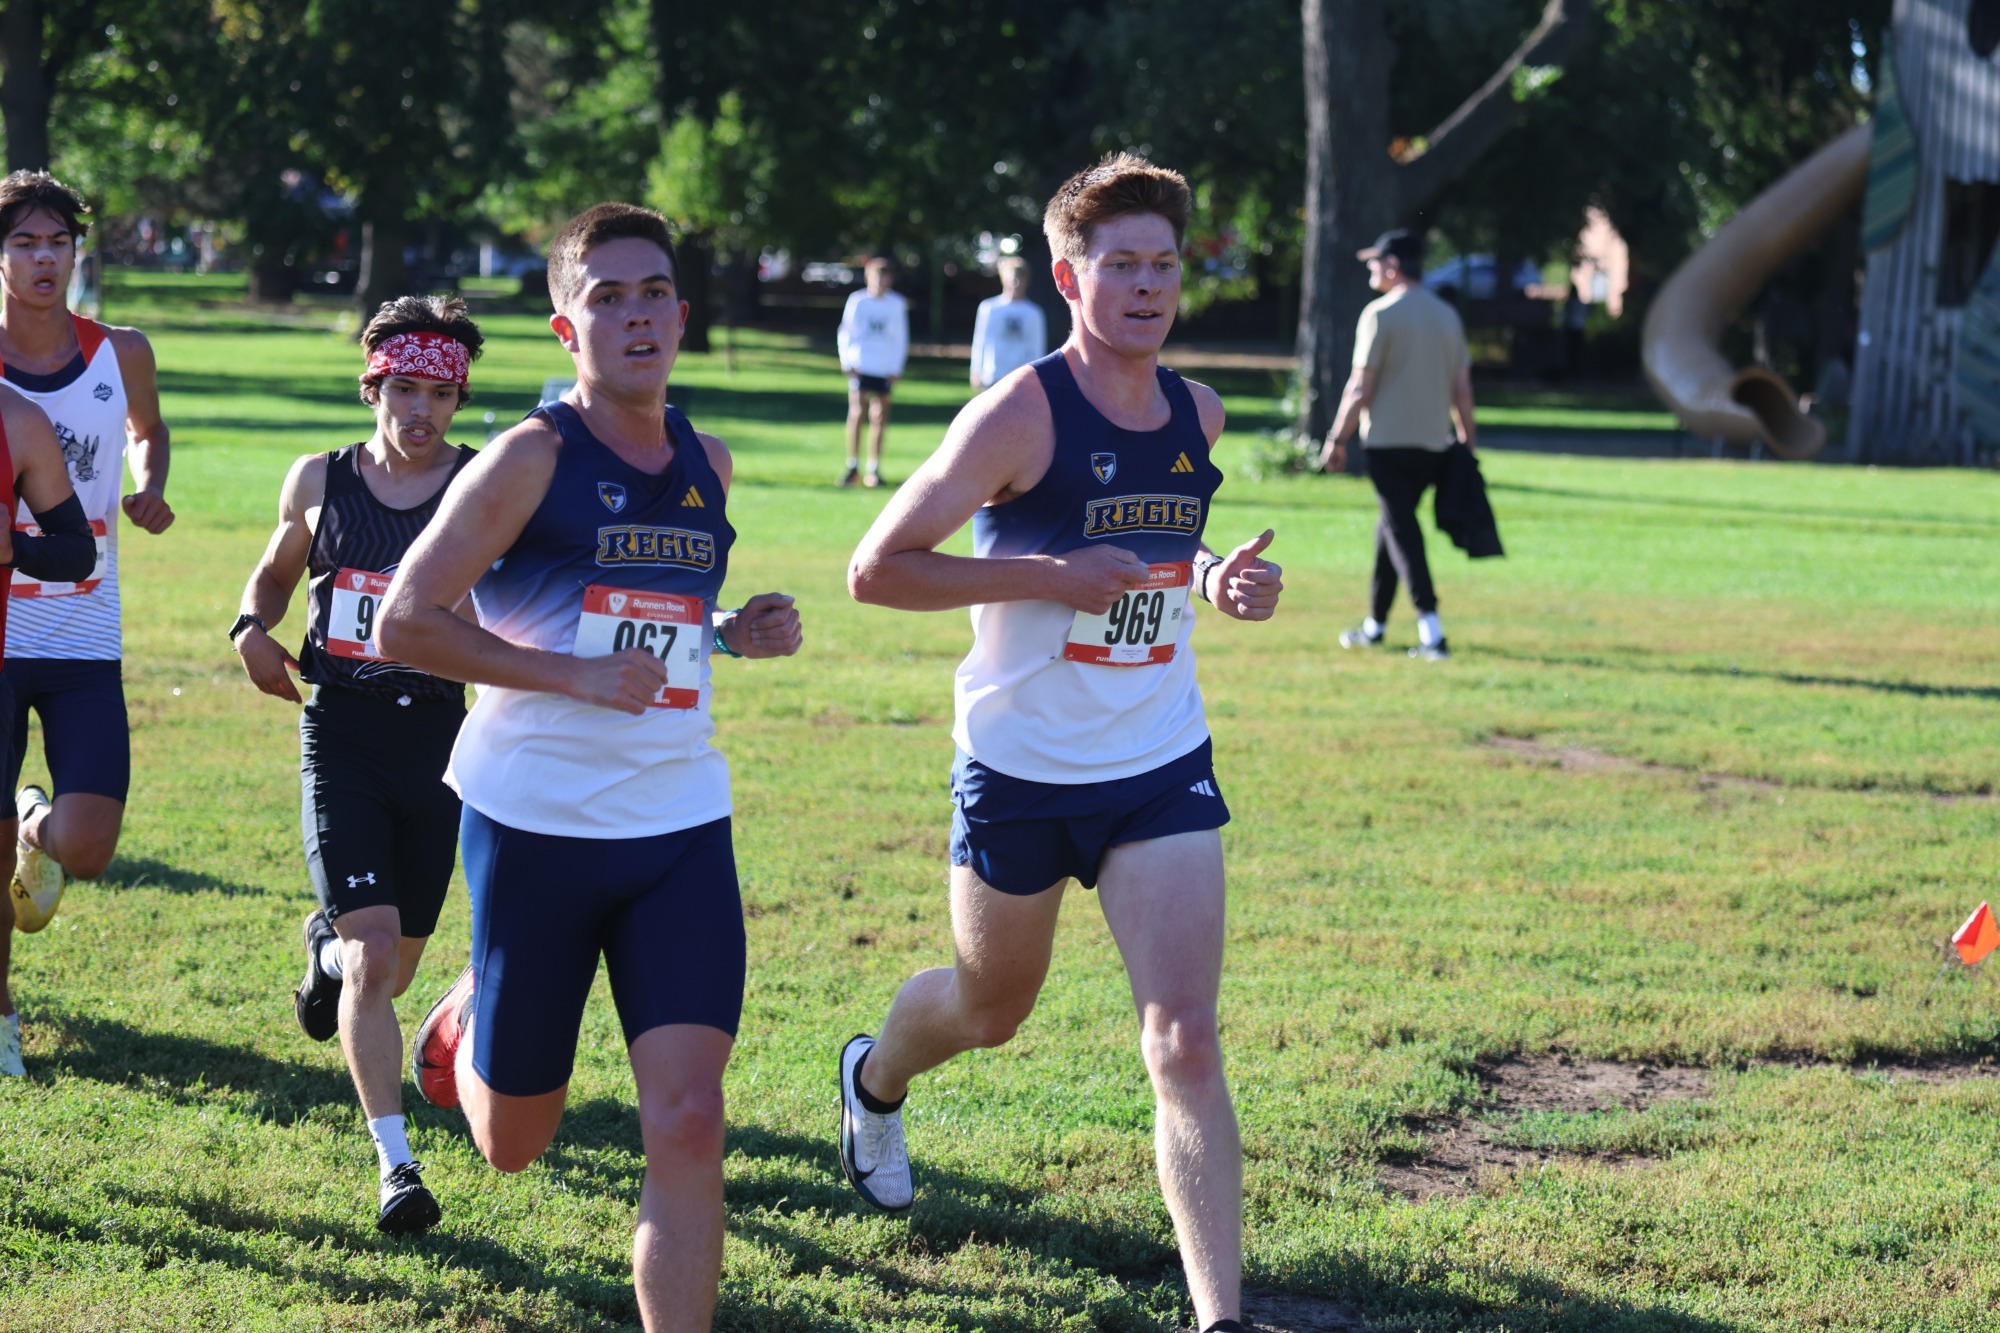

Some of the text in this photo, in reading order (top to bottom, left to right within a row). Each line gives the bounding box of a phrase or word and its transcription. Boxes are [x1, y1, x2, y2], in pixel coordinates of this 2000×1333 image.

[1086, 496, 1200, 535] REGIS
[598, 527, 714, 567] REGIS
[1158, 571, 1176, 579] Roost
[633, 599, 685, 613] Runners Roost
[1104, 591, 1165, 646] 969
